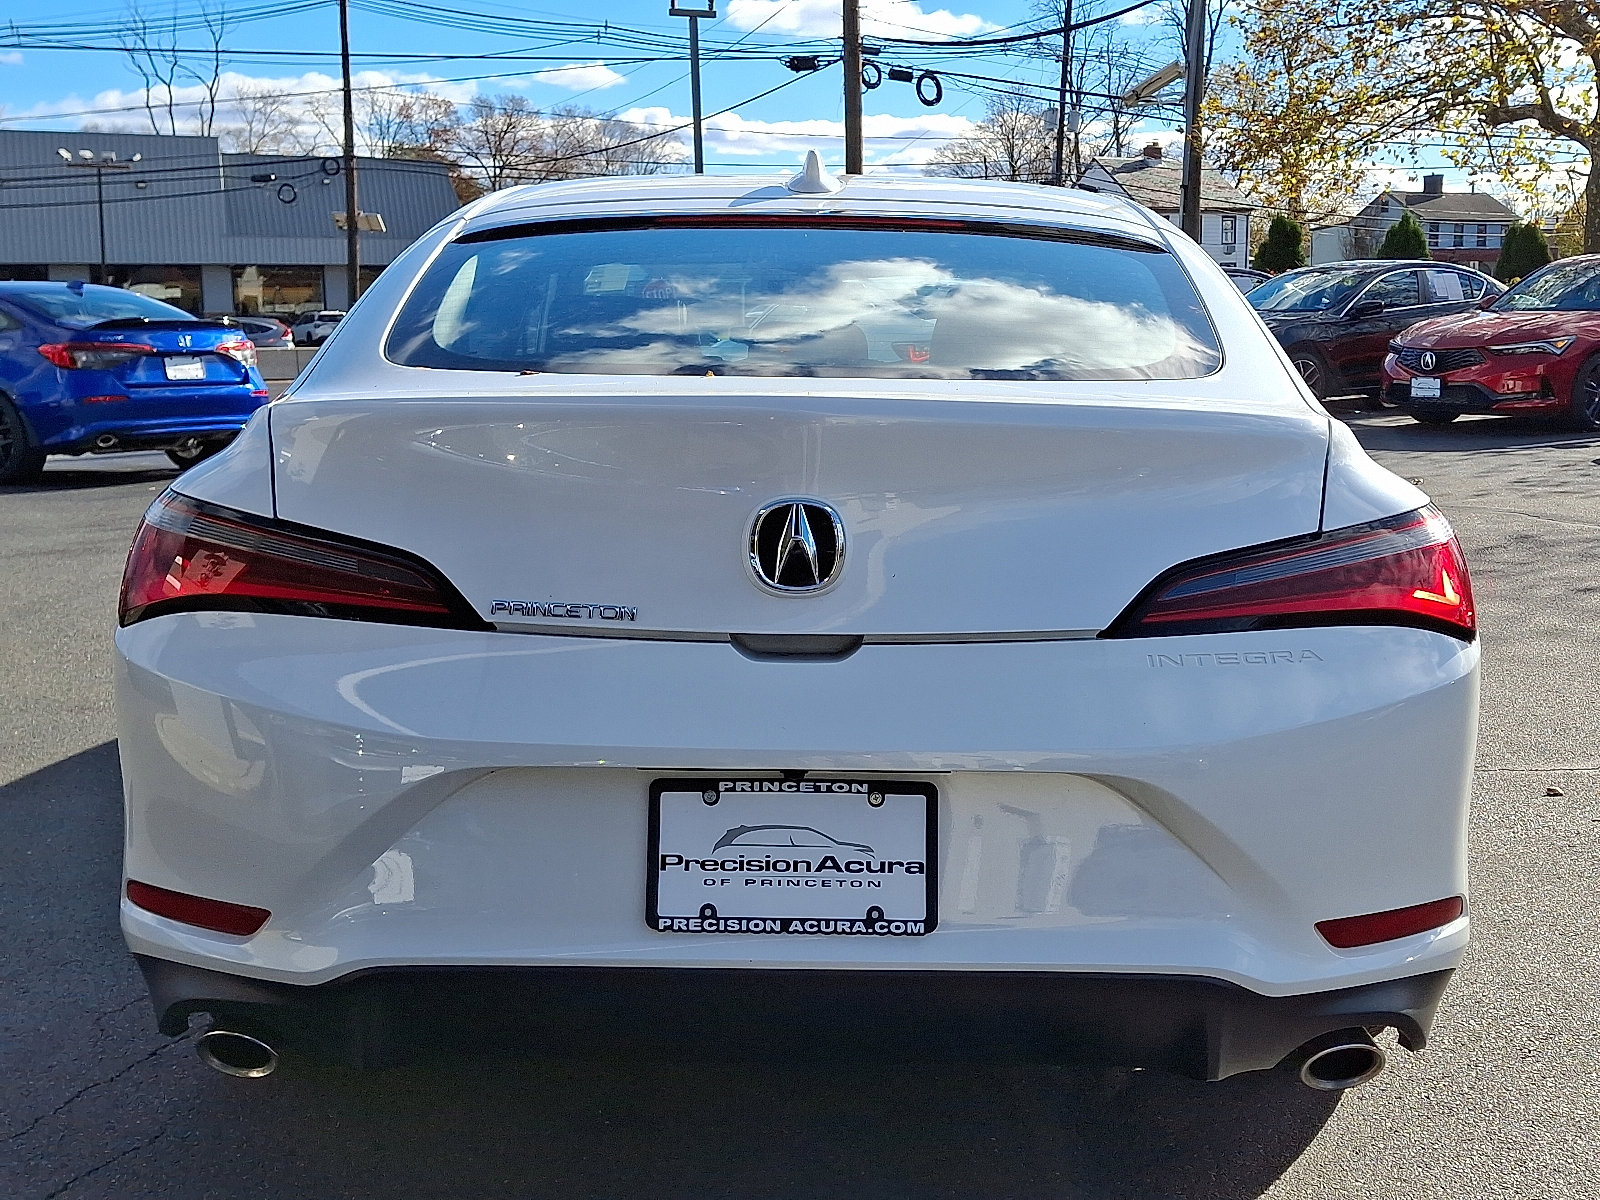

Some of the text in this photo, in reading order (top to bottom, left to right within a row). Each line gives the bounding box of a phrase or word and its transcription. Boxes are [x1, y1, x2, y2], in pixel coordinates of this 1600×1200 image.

[490, 600, 637, 621] PRINCETON
[1146, 649, 1324, 668] INTEGRA
[719, 782, 869, 793] PRINCETON
[660, 854, 925, 875] Precision Acura
[703, 878, 881, 888] OF PRINCETON
[658, 919, 925, 934] PRECISION ACURA.COM
